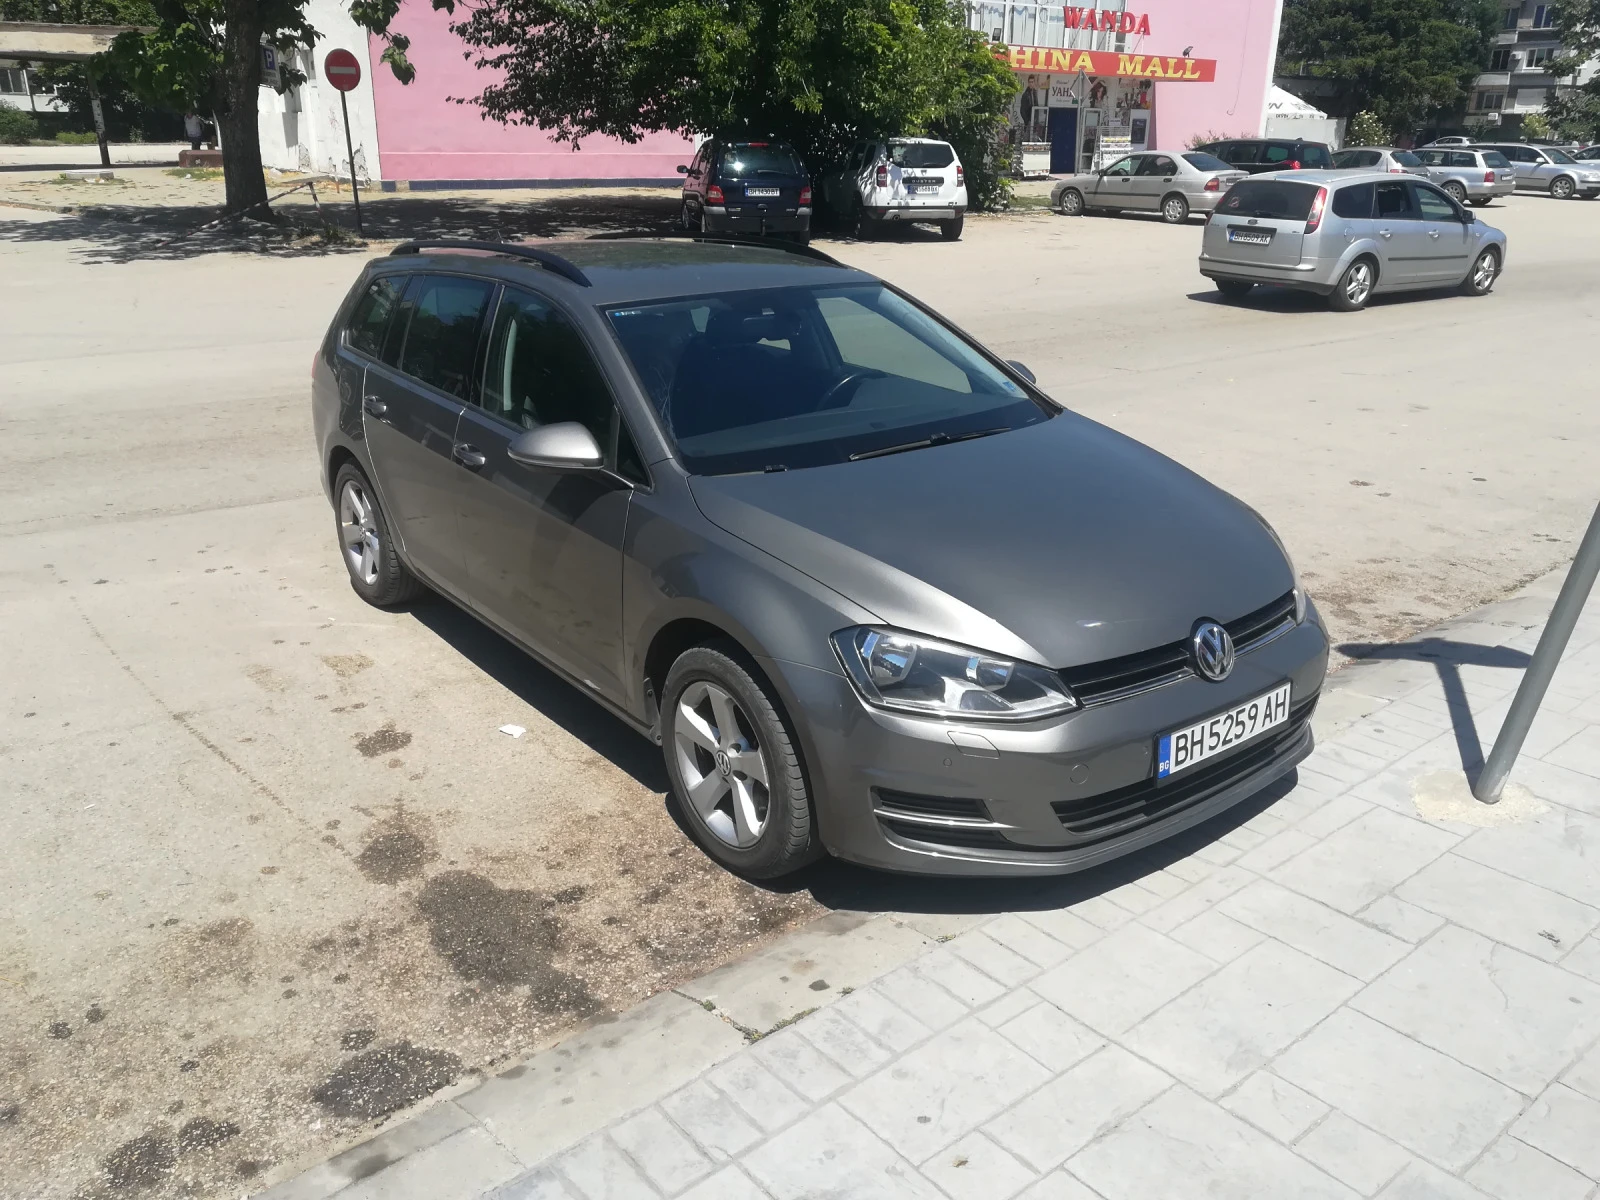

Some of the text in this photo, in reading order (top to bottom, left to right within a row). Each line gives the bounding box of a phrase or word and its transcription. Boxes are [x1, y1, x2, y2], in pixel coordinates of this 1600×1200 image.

[1063, 5, 1151, 36] WANDA
[987, 44, 1201, 79] HINA MALL
